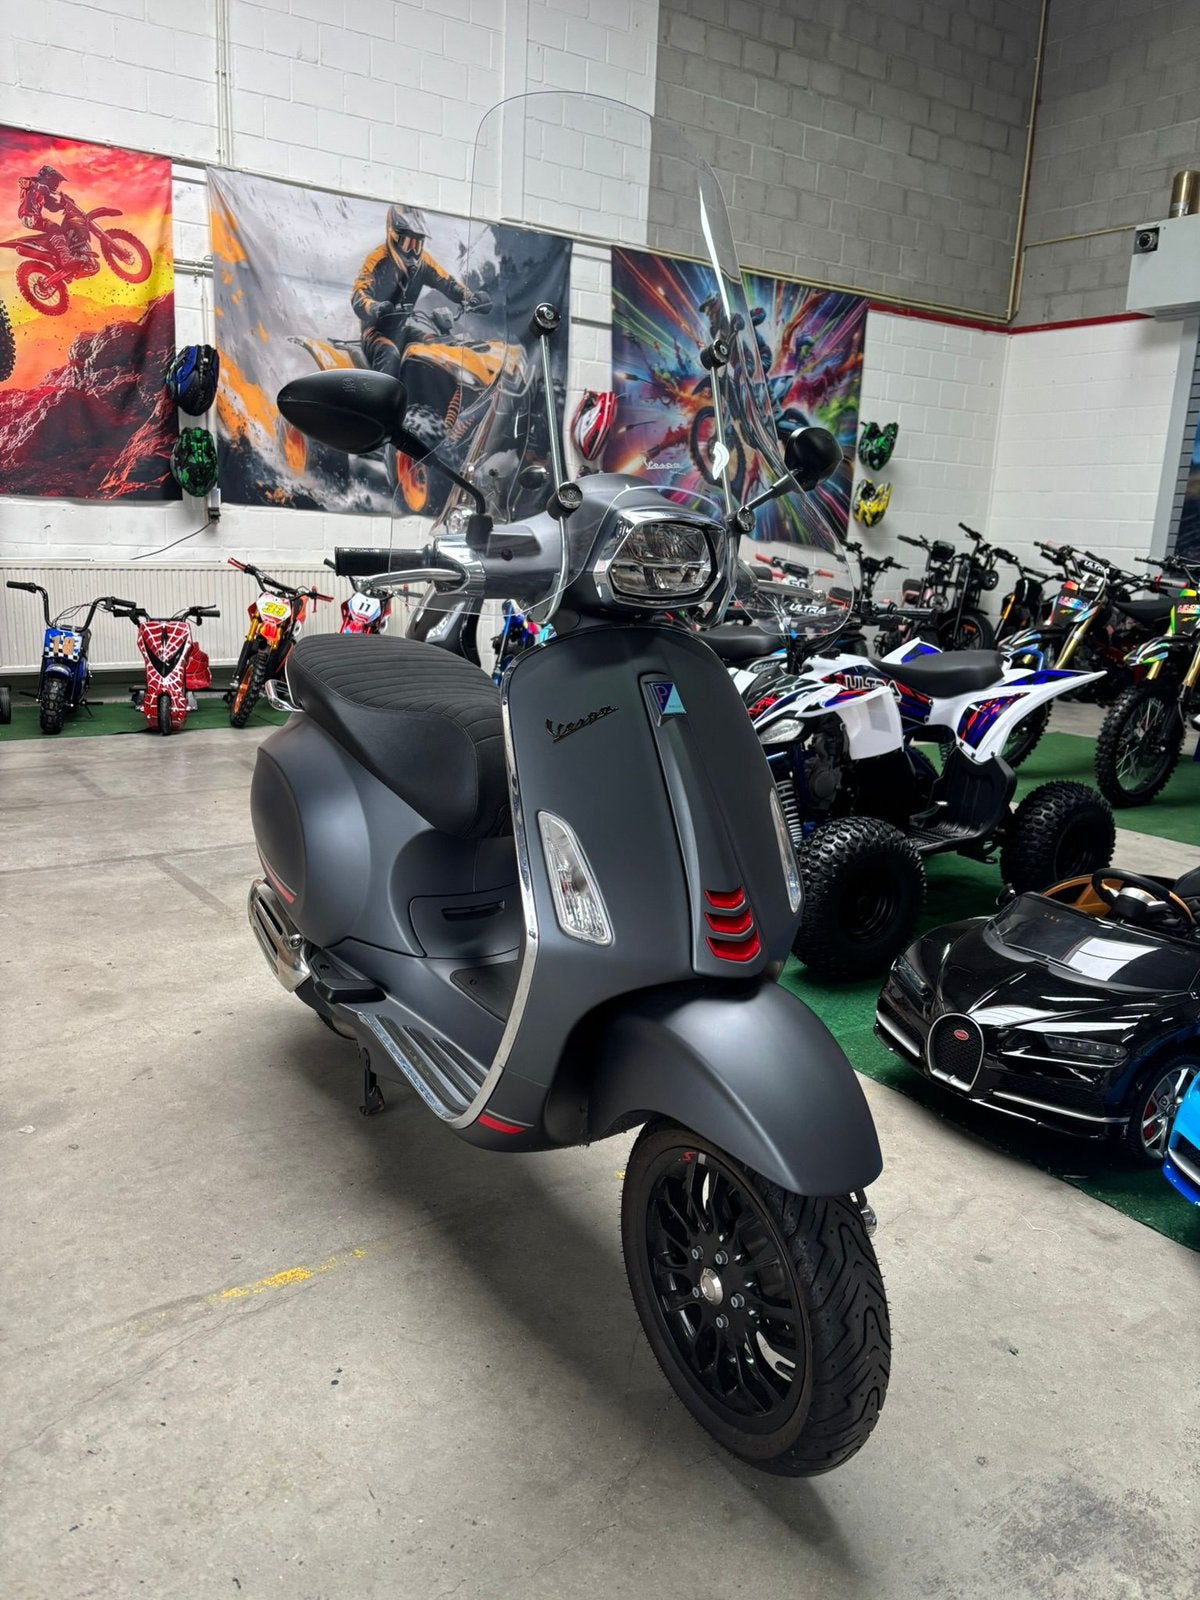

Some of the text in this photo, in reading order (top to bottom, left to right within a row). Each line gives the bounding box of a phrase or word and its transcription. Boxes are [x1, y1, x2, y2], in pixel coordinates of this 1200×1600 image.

[262, 602, 288, 617] 33
[359, 602, 371, 612] 11
[789, 602, 827, 616] ULTRA
[546, 706, 619, 744] Vespa
